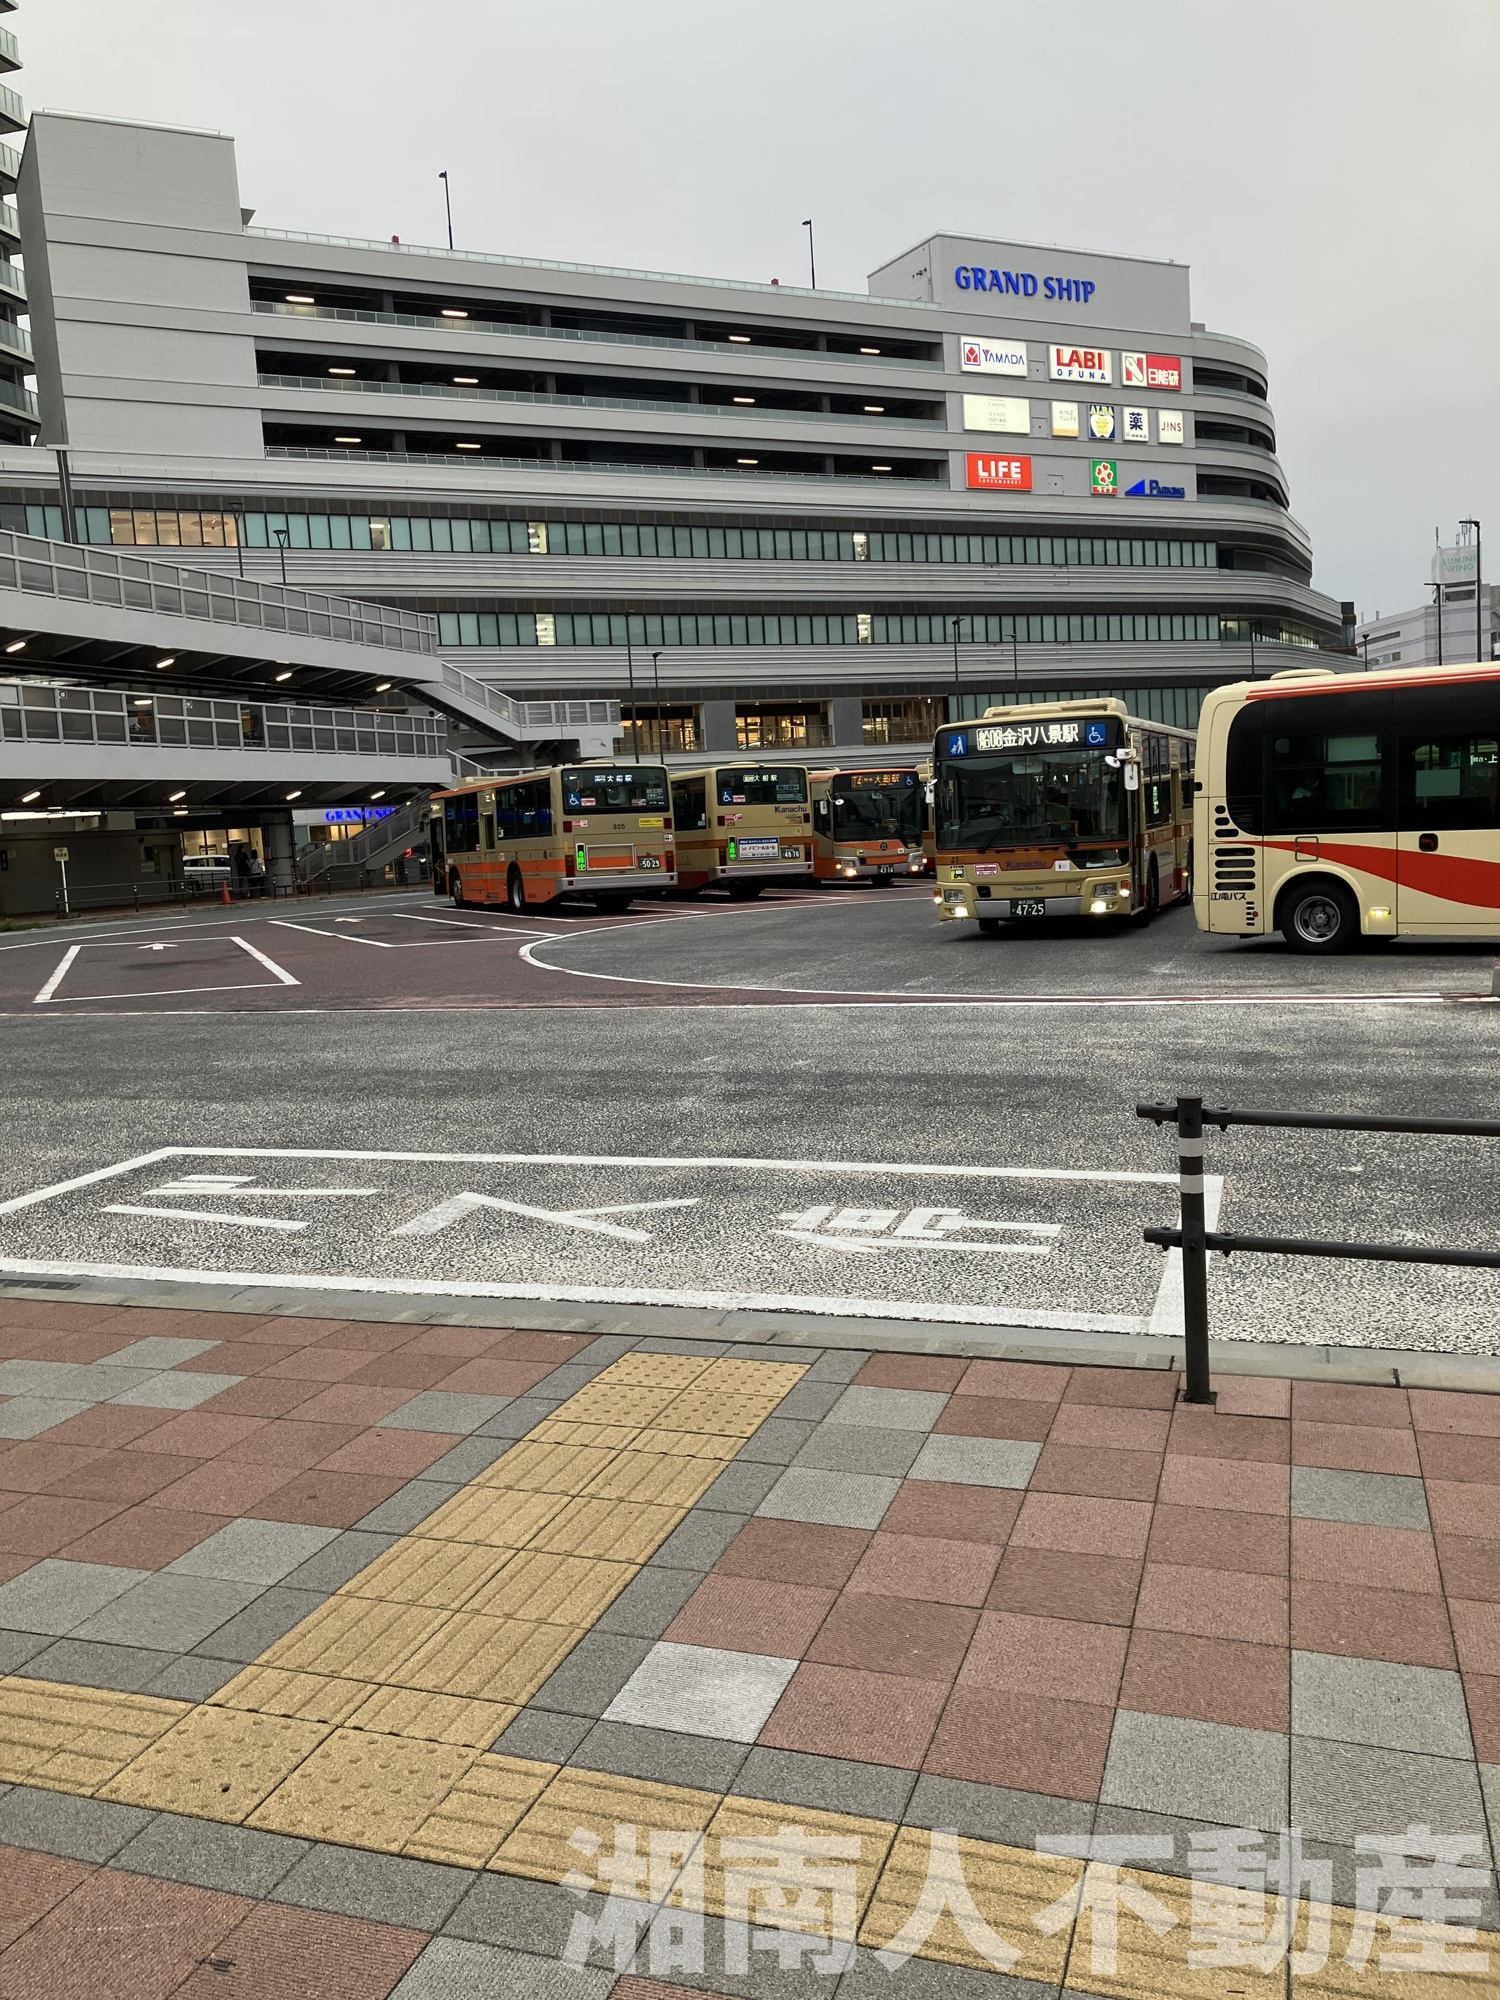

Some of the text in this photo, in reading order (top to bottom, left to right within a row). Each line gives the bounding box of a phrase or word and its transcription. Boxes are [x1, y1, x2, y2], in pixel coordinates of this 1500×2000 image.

[955, 265, 1096, 303] GRAND SHIP
[982, 348, 1025, 365] YAMADA
[1056, 348, 1106, 371] LABI
[1057, 368, 1106, 381] OFUNA
[1148, 368, 1180, 386] 日能研
[1128, 411, 1144, 431] 薬
[977, 459, 1022, 478] LIFE
[1445, 563, 1474, 573] WING
[1002, 723, 1079, 747] 金沢八景駅
[1006, 860, 1046, 868] Kanachu
[1016, 904, 1044, 915] 47-25
[99, 1174, 1063, 1254] バス停
